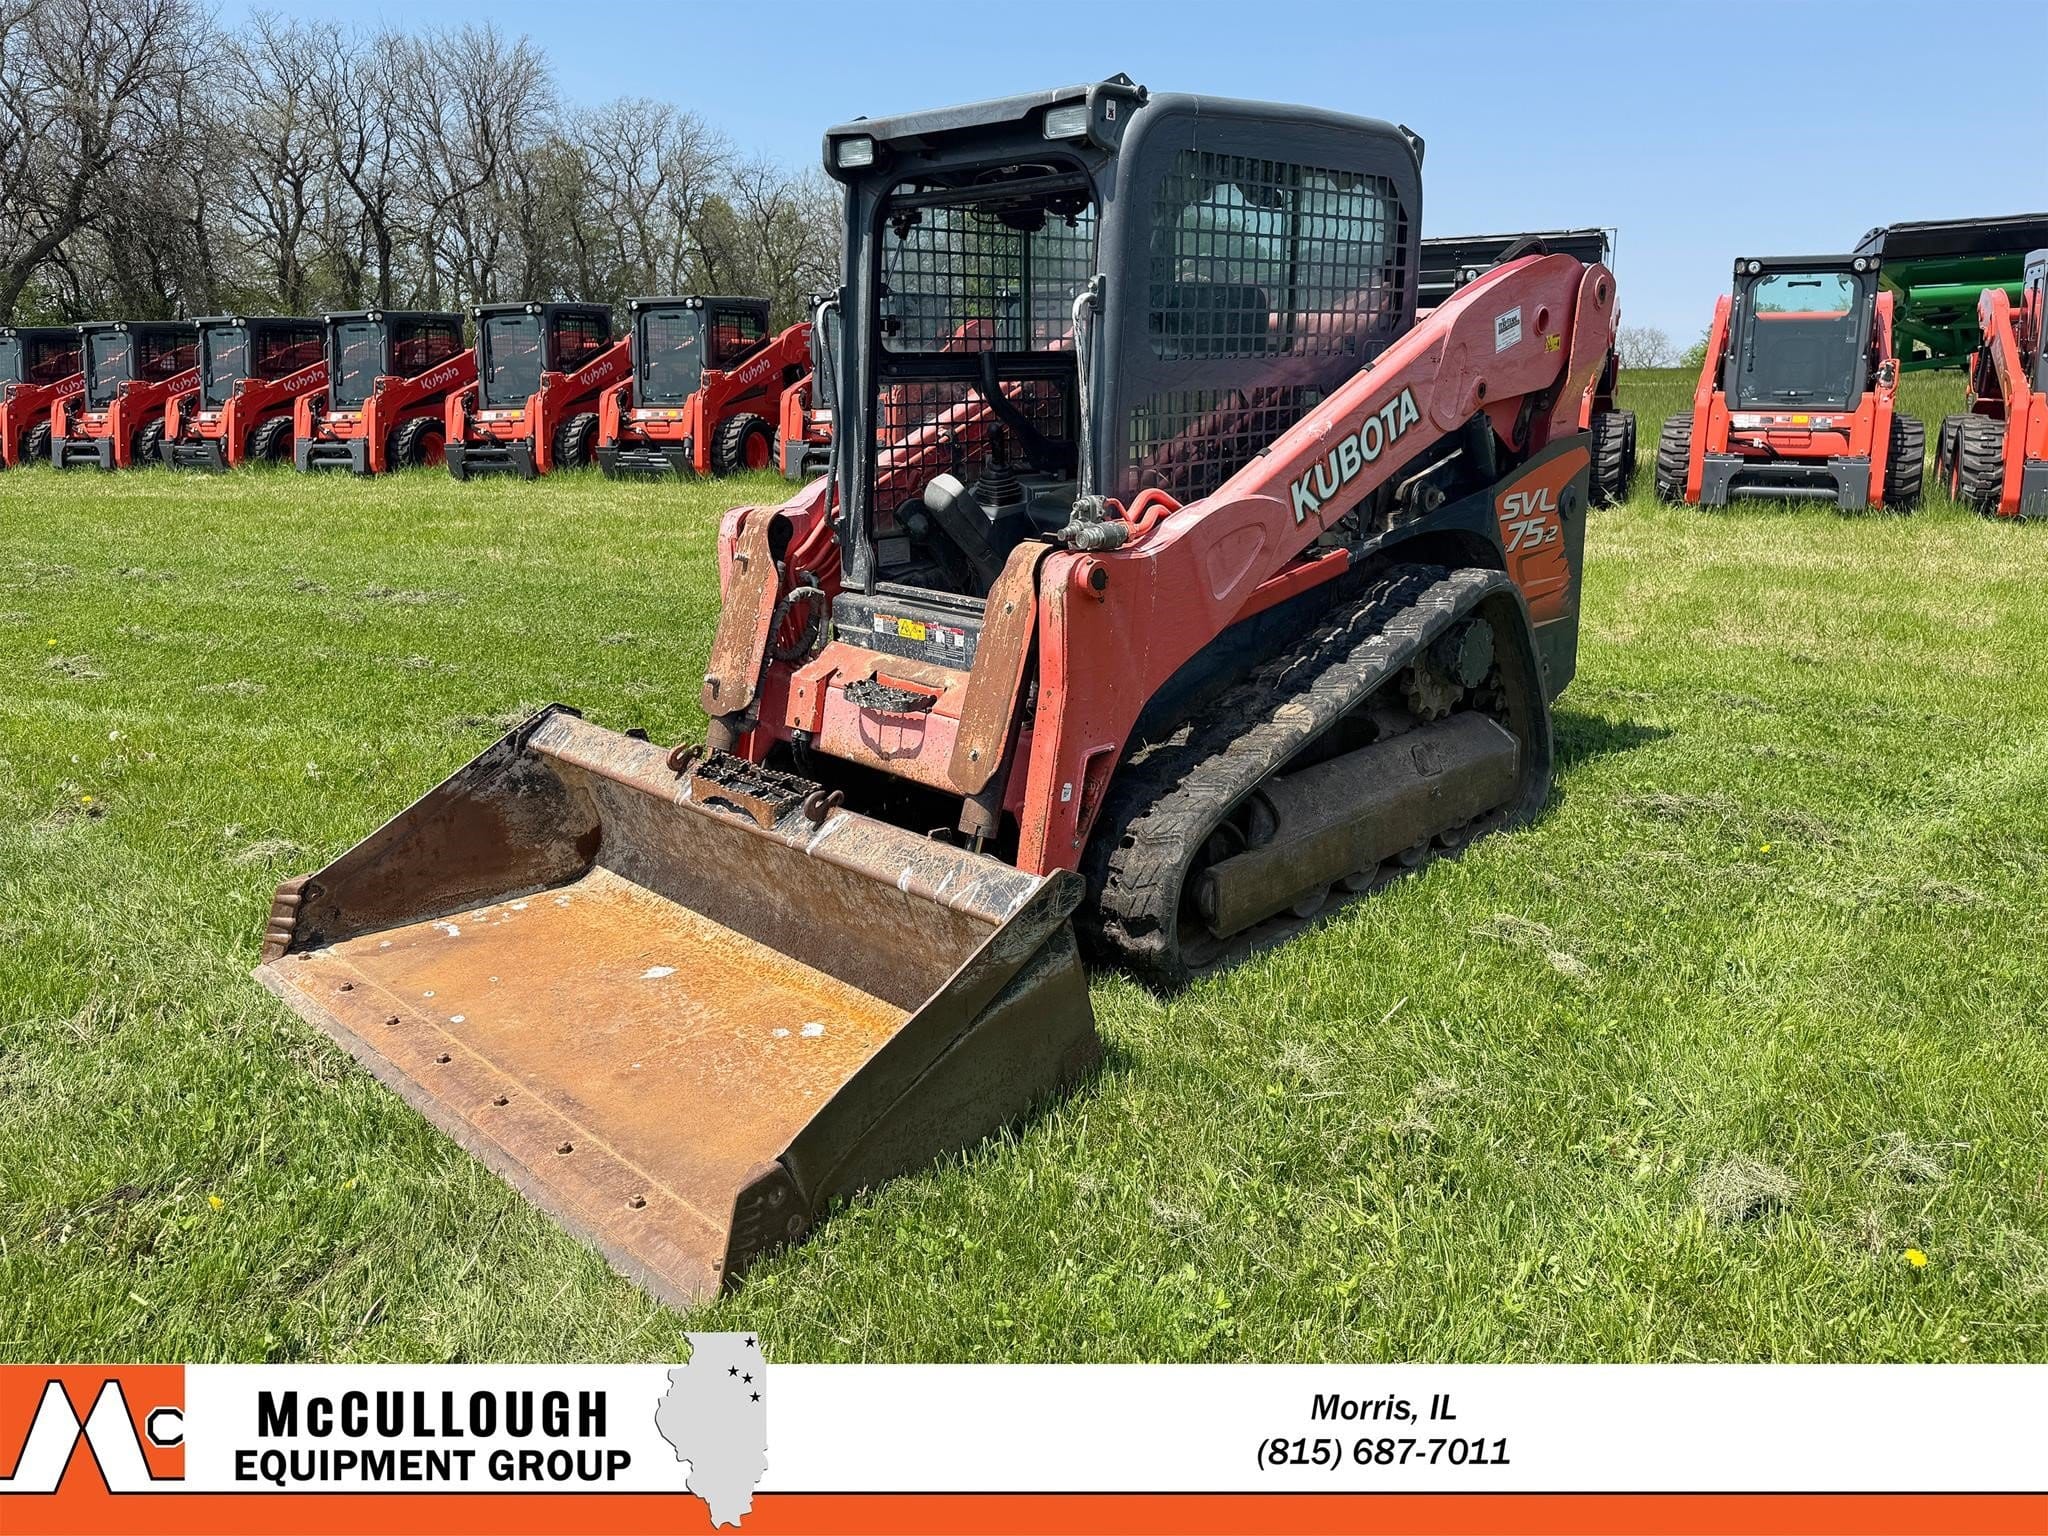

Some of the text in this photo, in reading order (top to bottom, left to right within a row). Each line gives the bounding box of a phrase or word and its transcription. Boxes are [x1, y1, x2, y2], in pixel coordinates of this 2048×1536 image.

[283, 369, 325, 392] Kubota
[420, 366, 460, 390] Kubota
[580, 361, 613, 385] Kubota
[739, 358, 771, 384] Kubota
[1290, 387, 1420, 524] KUBOTA
[1500, 487, 1556, 521] SVL
[1506, 516, 1559, 553] 75-2
